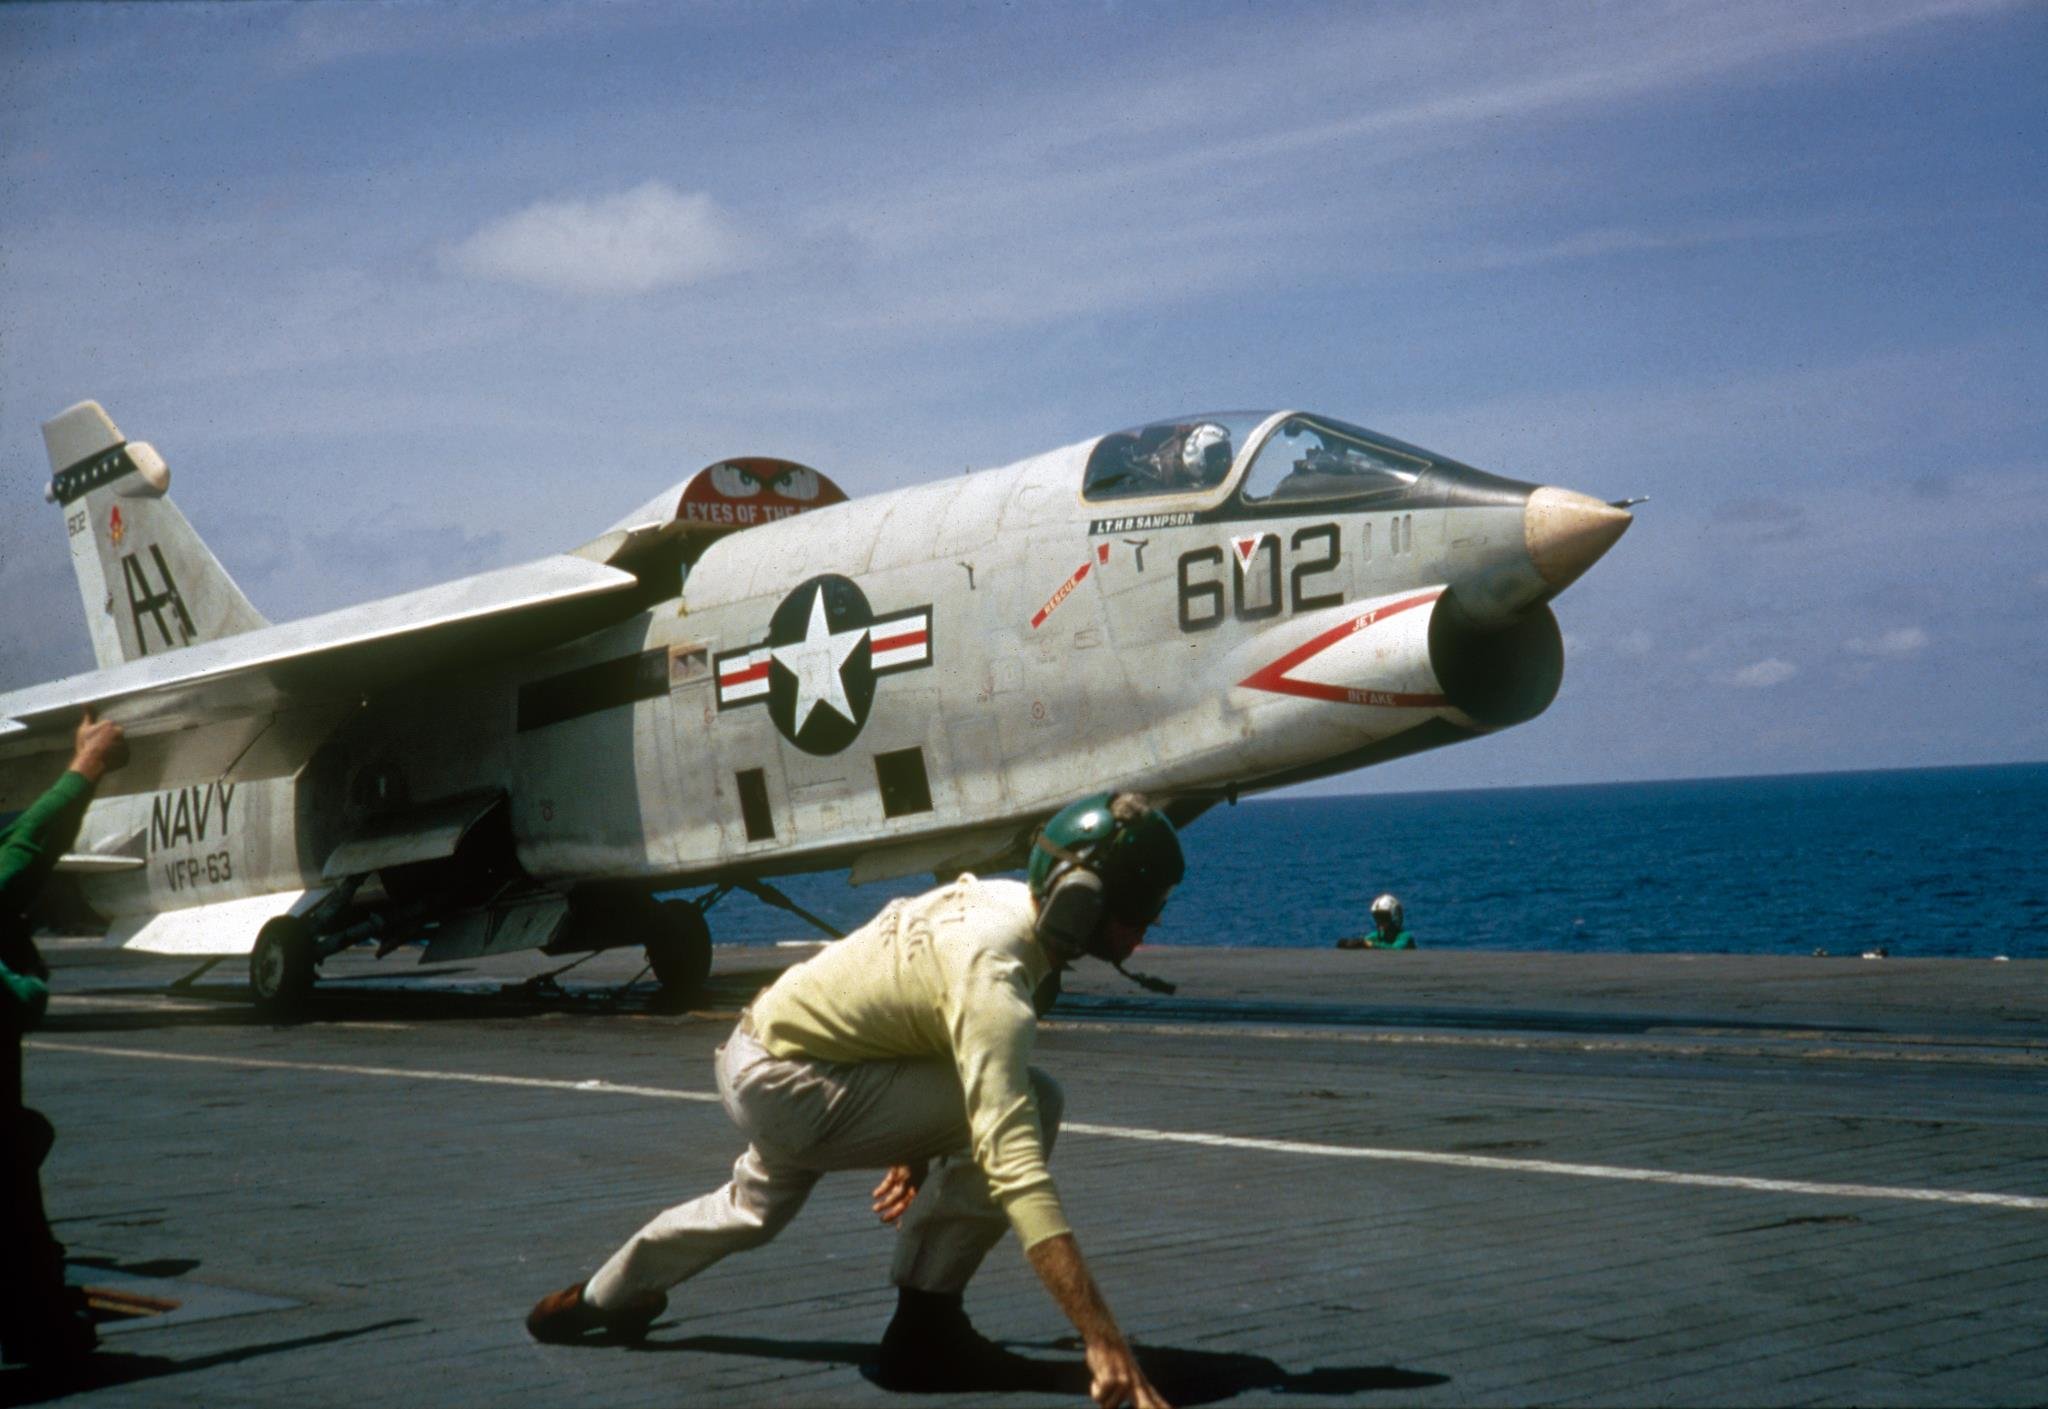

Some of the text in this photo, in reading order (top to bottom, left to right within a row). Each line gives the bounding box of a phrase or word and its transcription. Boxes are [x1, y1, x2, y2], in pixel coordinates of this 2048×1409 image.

[686, 501, 734, 524] EYES
[736, 504, 759, 524] OF
[1135, 512, 1195, 530] SAMPSON
[1177, 522, 1345, 634] 602
[121, 543, 198, 656] AH
[1044, 577, 1077, 616] RESCUE
[1352, 611, 1377, 632] JET
[1347, 689, 1396, 706] INTAKE
[151, 782, 235, 853] NAVY
